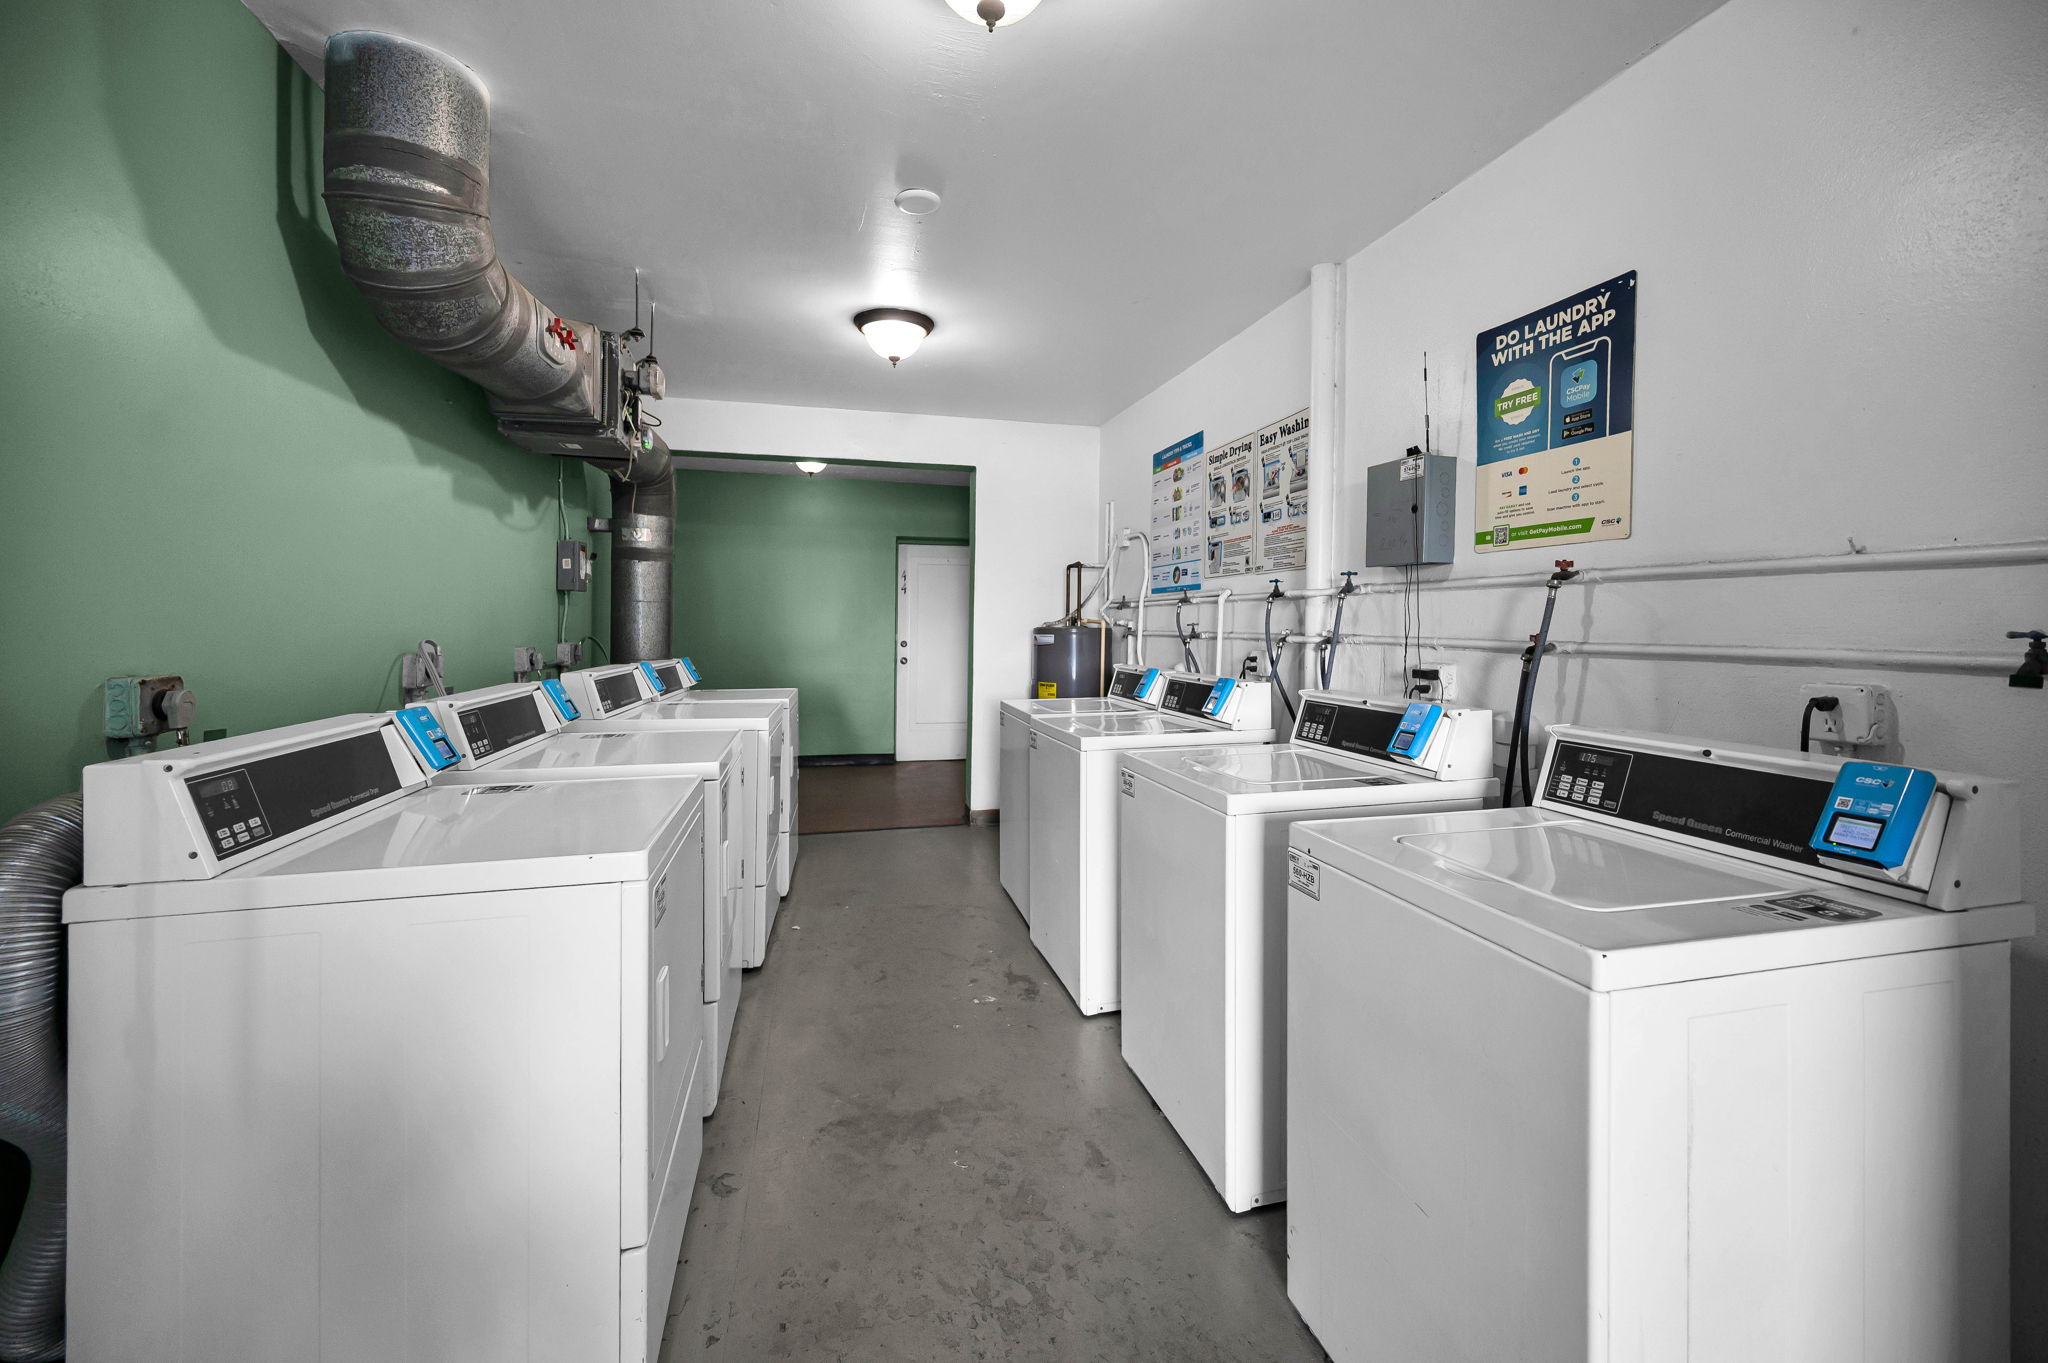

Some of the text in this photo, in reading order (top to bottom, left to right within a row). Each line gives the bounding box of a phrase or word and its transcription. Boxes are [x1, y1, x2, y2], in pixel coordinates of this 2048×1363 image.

[1496, 291, 1612, 350] DO LAUNDRY
[1491, 309, 1616, 367] WITH THE APP
[1497, 392, 1538, 412] TRY FREE
[1566, 391, 1590, 402] Mobile
[1260, 418, 1309, 446] Easy Washin
[1208, 450, 1228, 466] Simple
[1229, 441, 1252, 457] Drying
[1529, 524, 1582, 535] GetPayMobile.com
[1856, 776, 1881, 785] CSC
[1652, 810, 1803, 853] Speed Queen Commercial Washer
